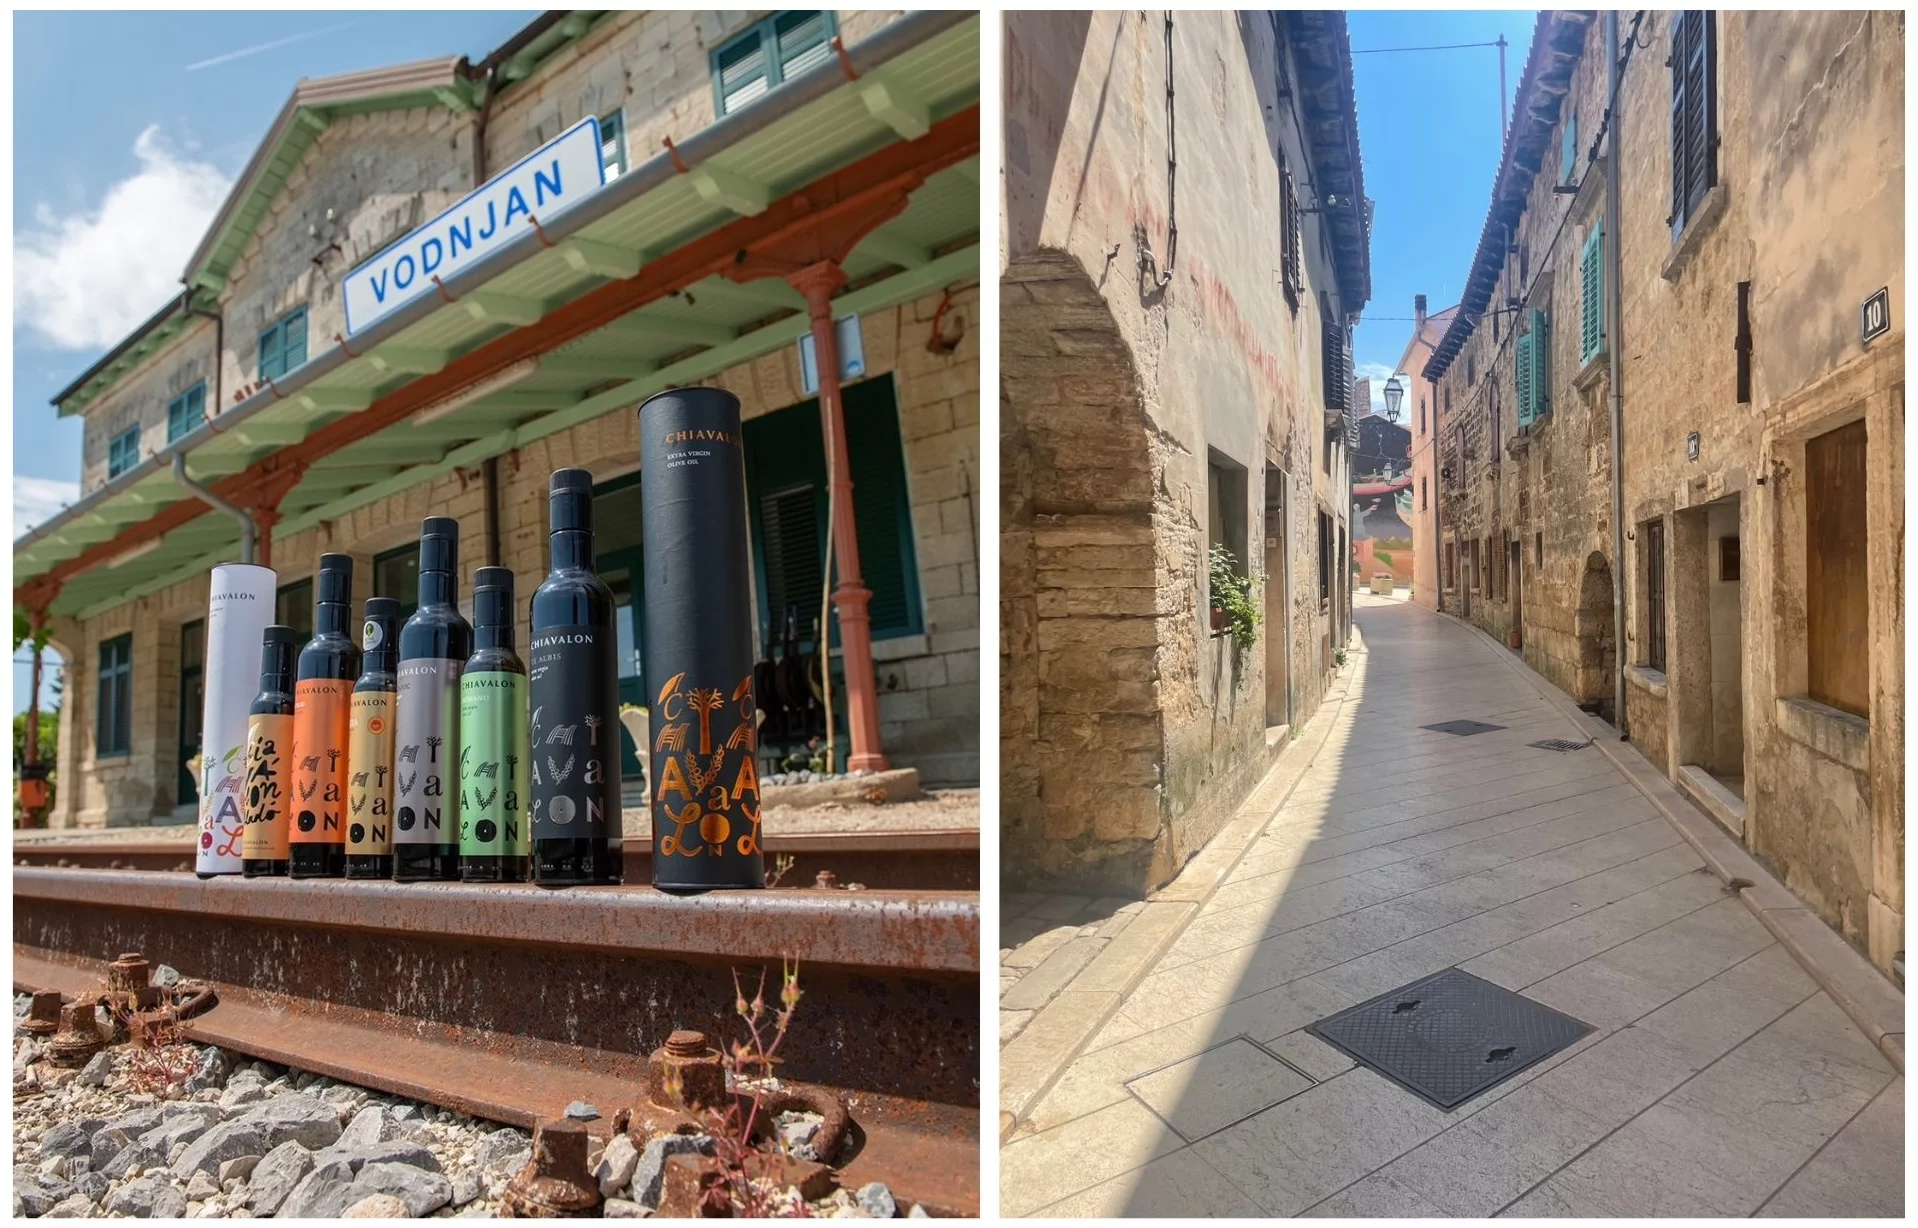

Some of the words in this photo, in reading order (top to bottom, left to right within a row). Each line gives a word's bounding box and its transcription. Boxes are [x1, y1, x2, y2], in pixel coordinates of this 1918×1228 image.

[369, 159, 563, 304] VODNJAN
[1867, 301, 1881, 332] 10
[667, 451, 687, 460] EXTRA
[531, 634, 593, 650] CHIAVALON
[539, 653, 562, 663] ALBIS
